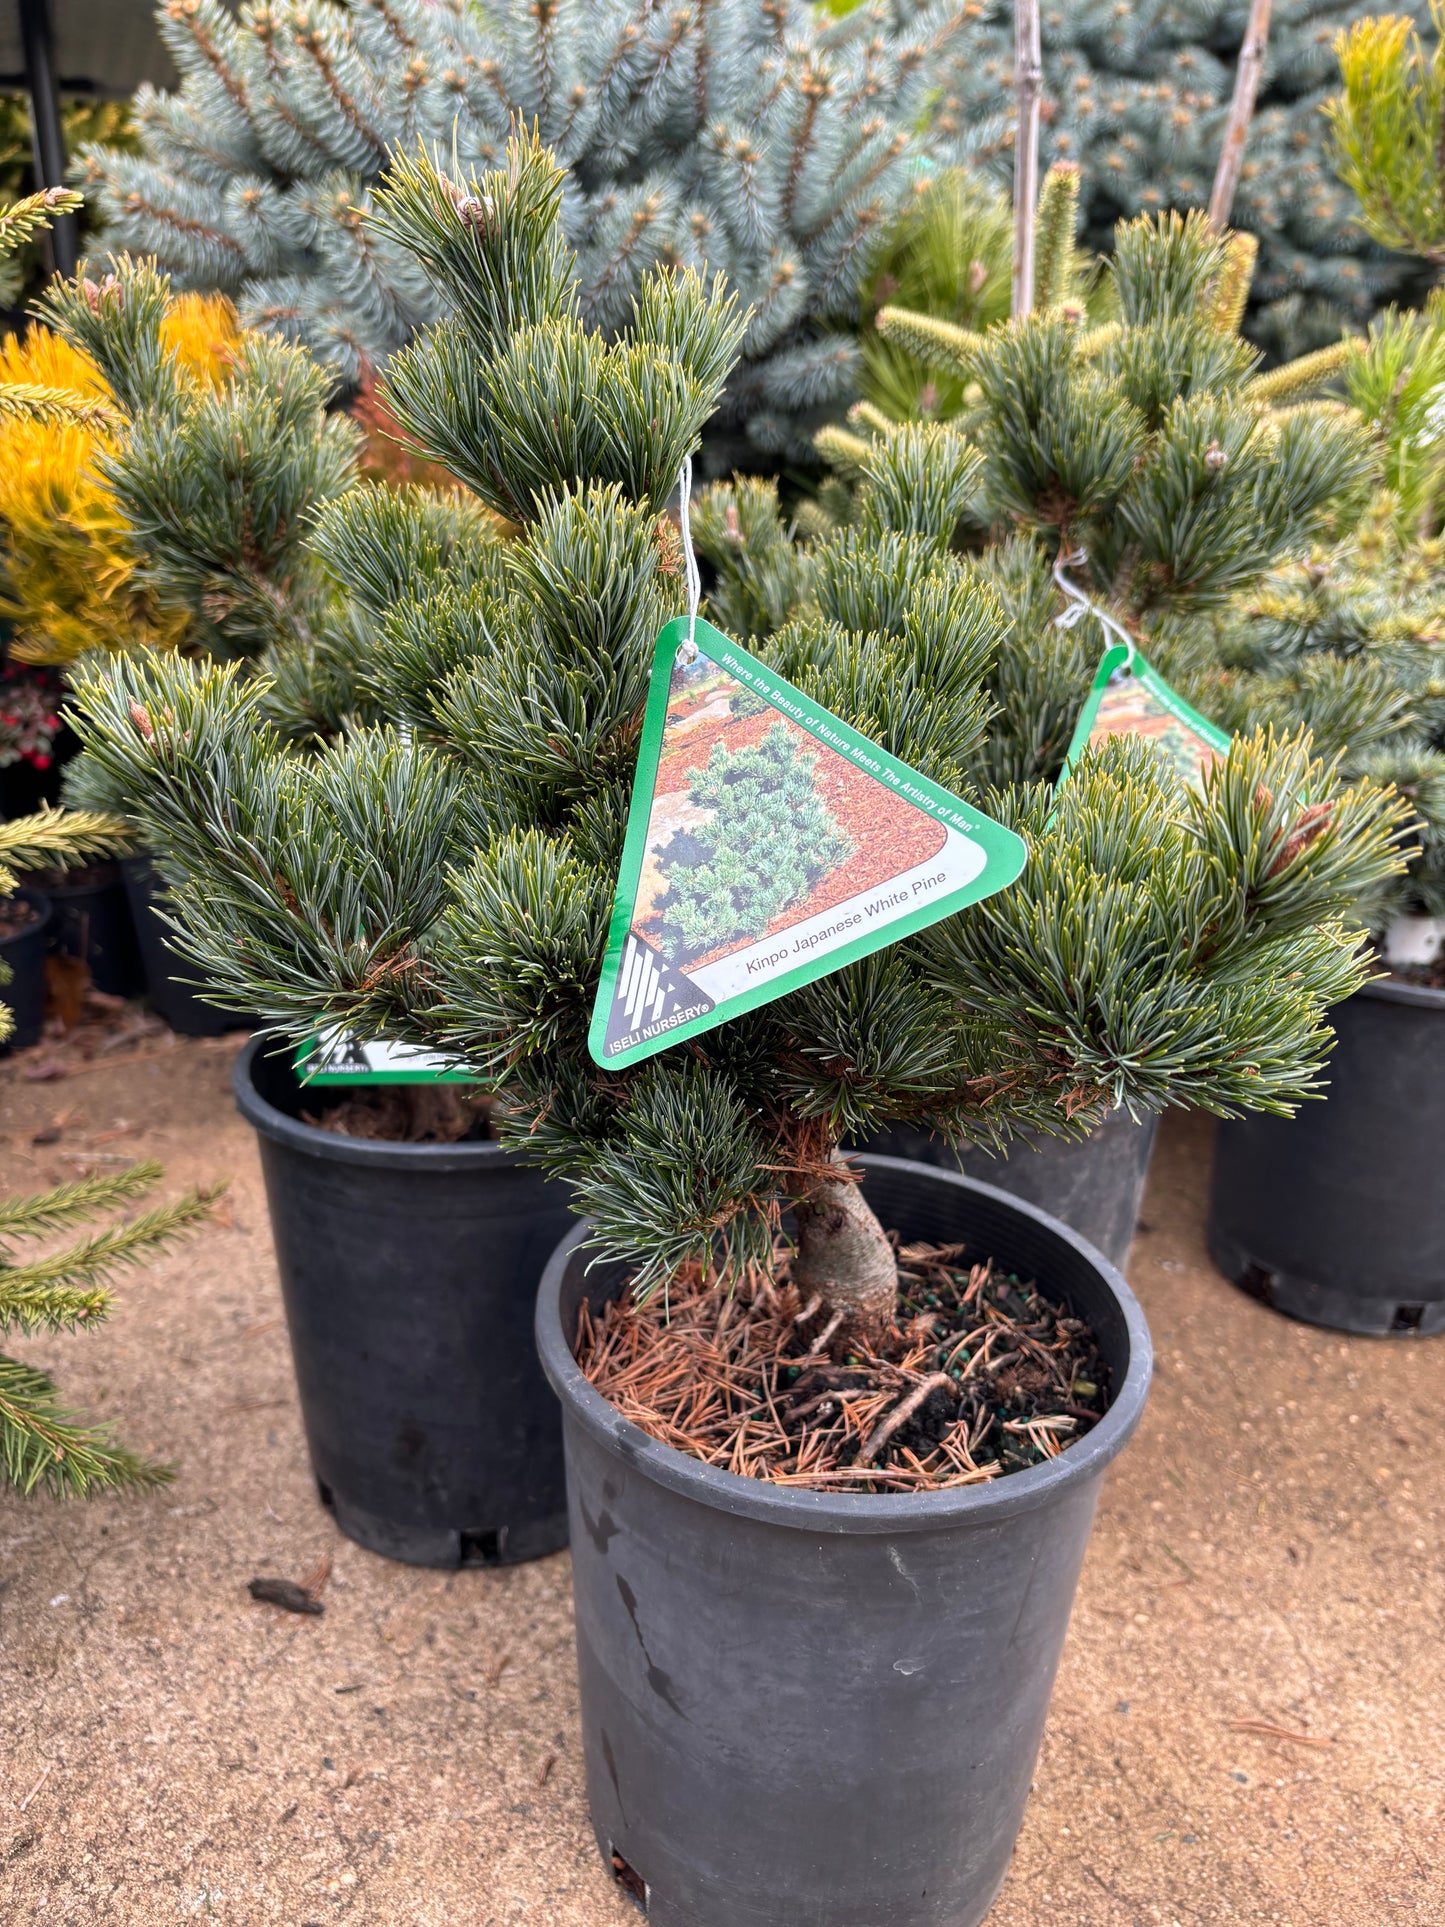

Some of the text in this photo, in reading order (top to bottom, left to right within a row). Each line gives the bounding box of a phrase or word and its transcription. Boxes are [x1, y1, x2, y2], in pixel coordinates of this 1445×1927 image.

[721, 653, 753, 681] Where
[753, 677, 770, 693] the
[770, 689, 805, 720] Beauty
[805, 715, 818, 728] of
[816, 722, 850, 751] Nature
[850, 747, 881, 773] Meets
[881, 768, 900, 785] The
[899, 781, 937, 811] Artistry
[937, 805, 952, 818] of
[745, 870, 947, 975] Kinpo Japanese White Pine
[609, 1026, 641, 1055] ISELI
